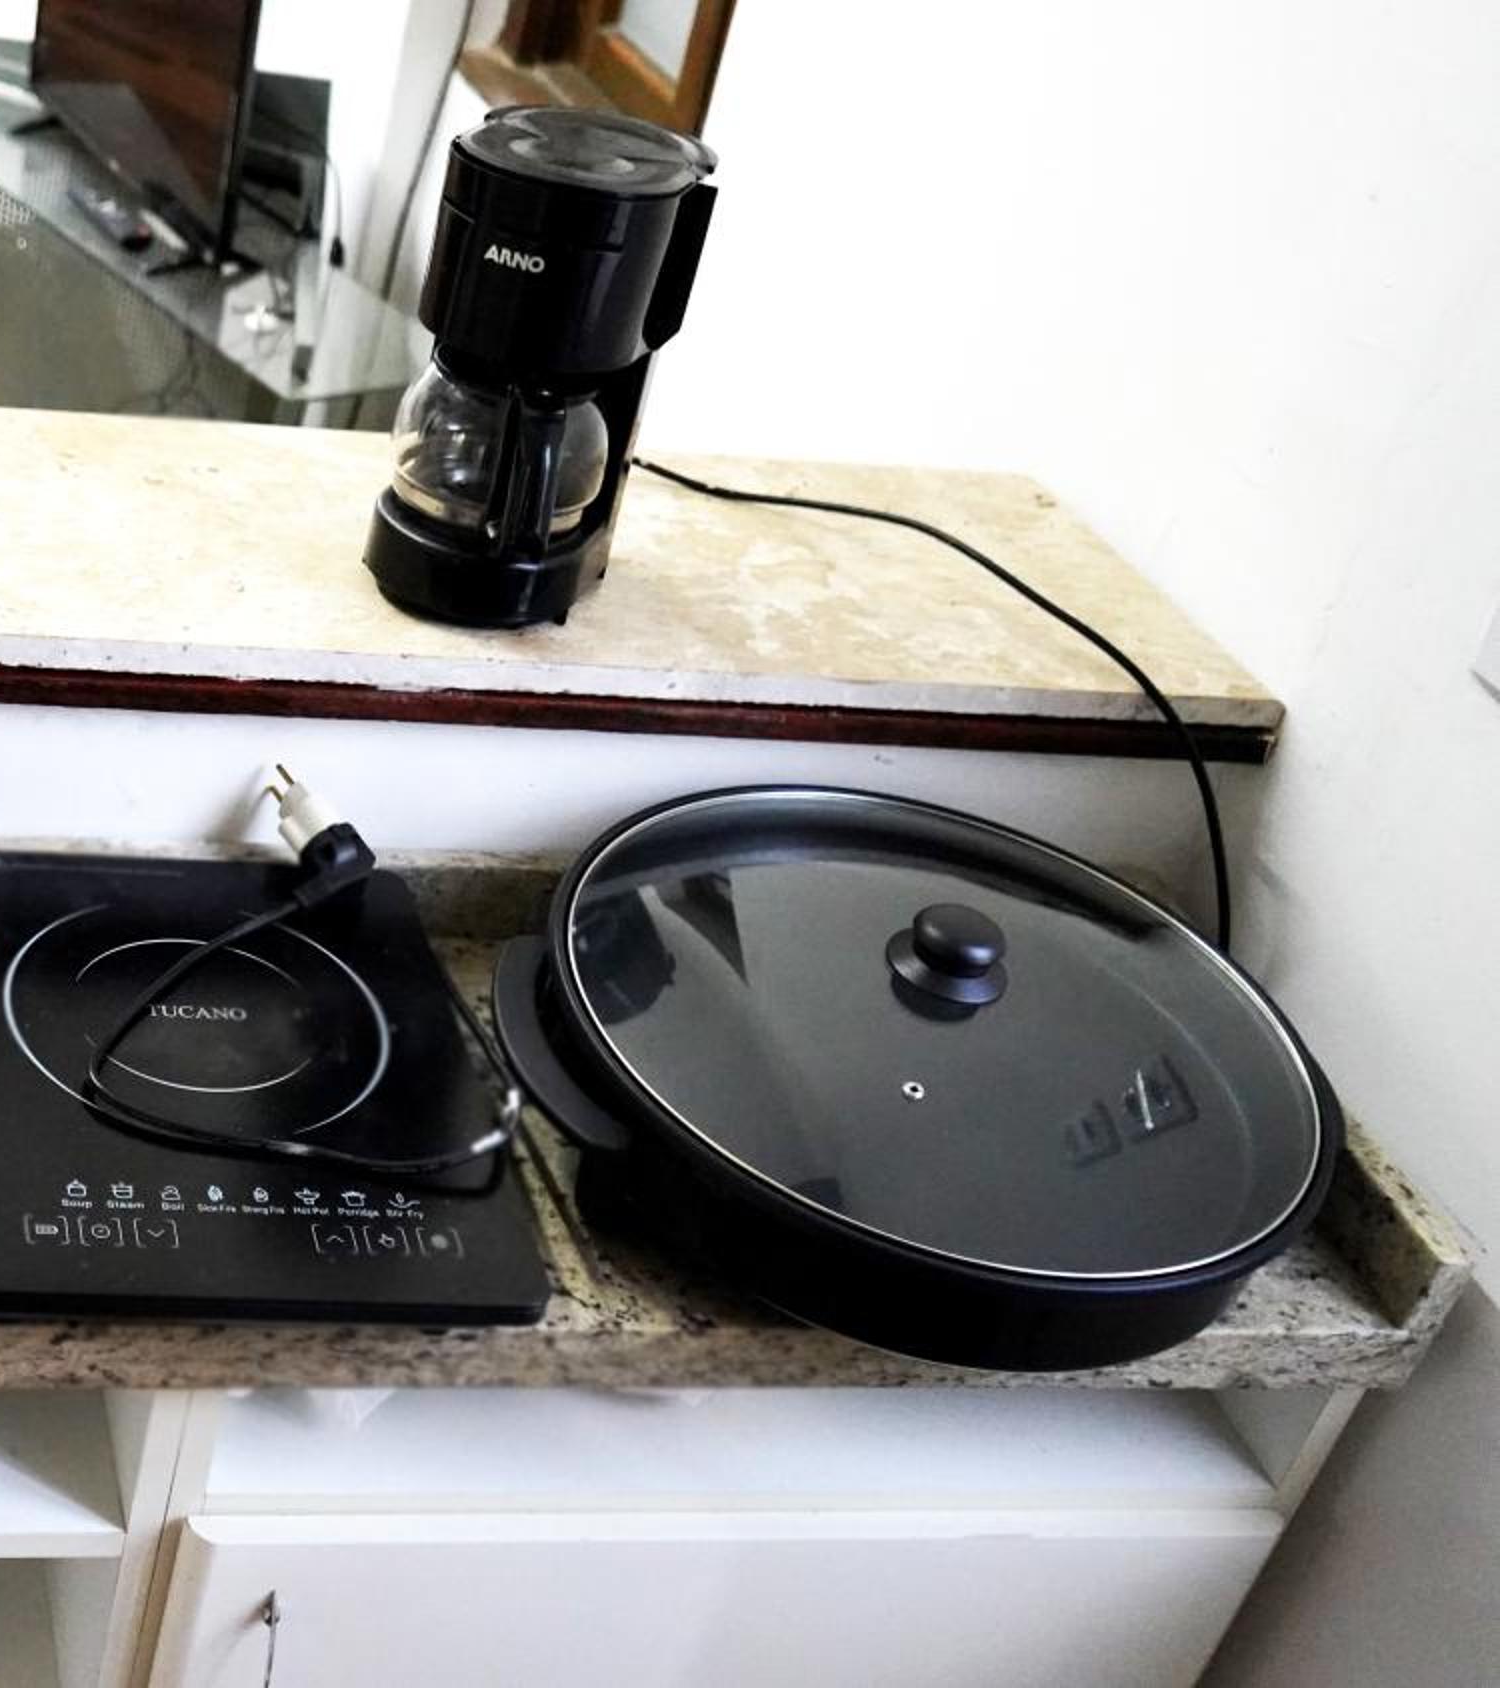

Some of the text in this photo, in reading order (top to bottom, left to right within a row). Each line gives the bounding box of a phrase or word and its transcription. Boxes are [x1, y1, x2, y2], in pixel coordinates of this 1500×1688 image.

[484, 244, 545, 273] ARNO
[150, 1004, 248, 1021] TUCANO
[61, 1199, 93, 1209] Soup
[106, 1199, 145, 1209] Steam
[161, 1202, 185, 1211] Boil
